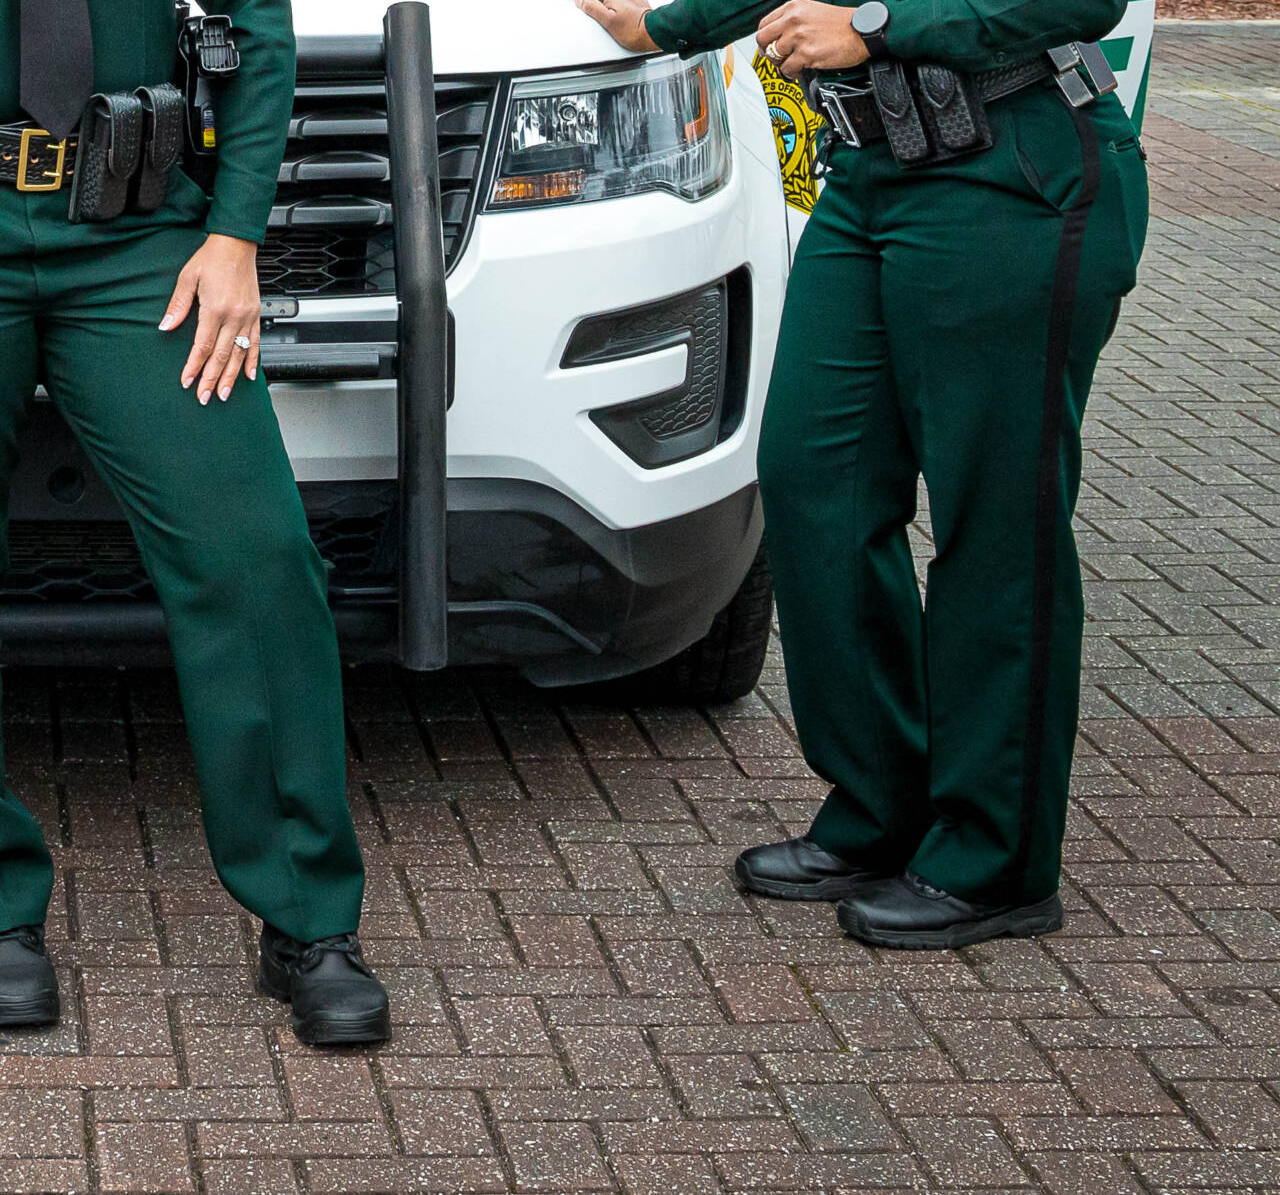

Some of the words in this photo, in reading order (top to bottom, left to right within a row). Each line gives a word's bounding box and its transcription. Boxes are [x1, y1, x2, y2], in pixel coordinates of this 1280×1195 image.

[763, 81, 776, 92] F'S
[778, 82, 804, 106] OFFICE
[766, 96, 784, 106] LAY
